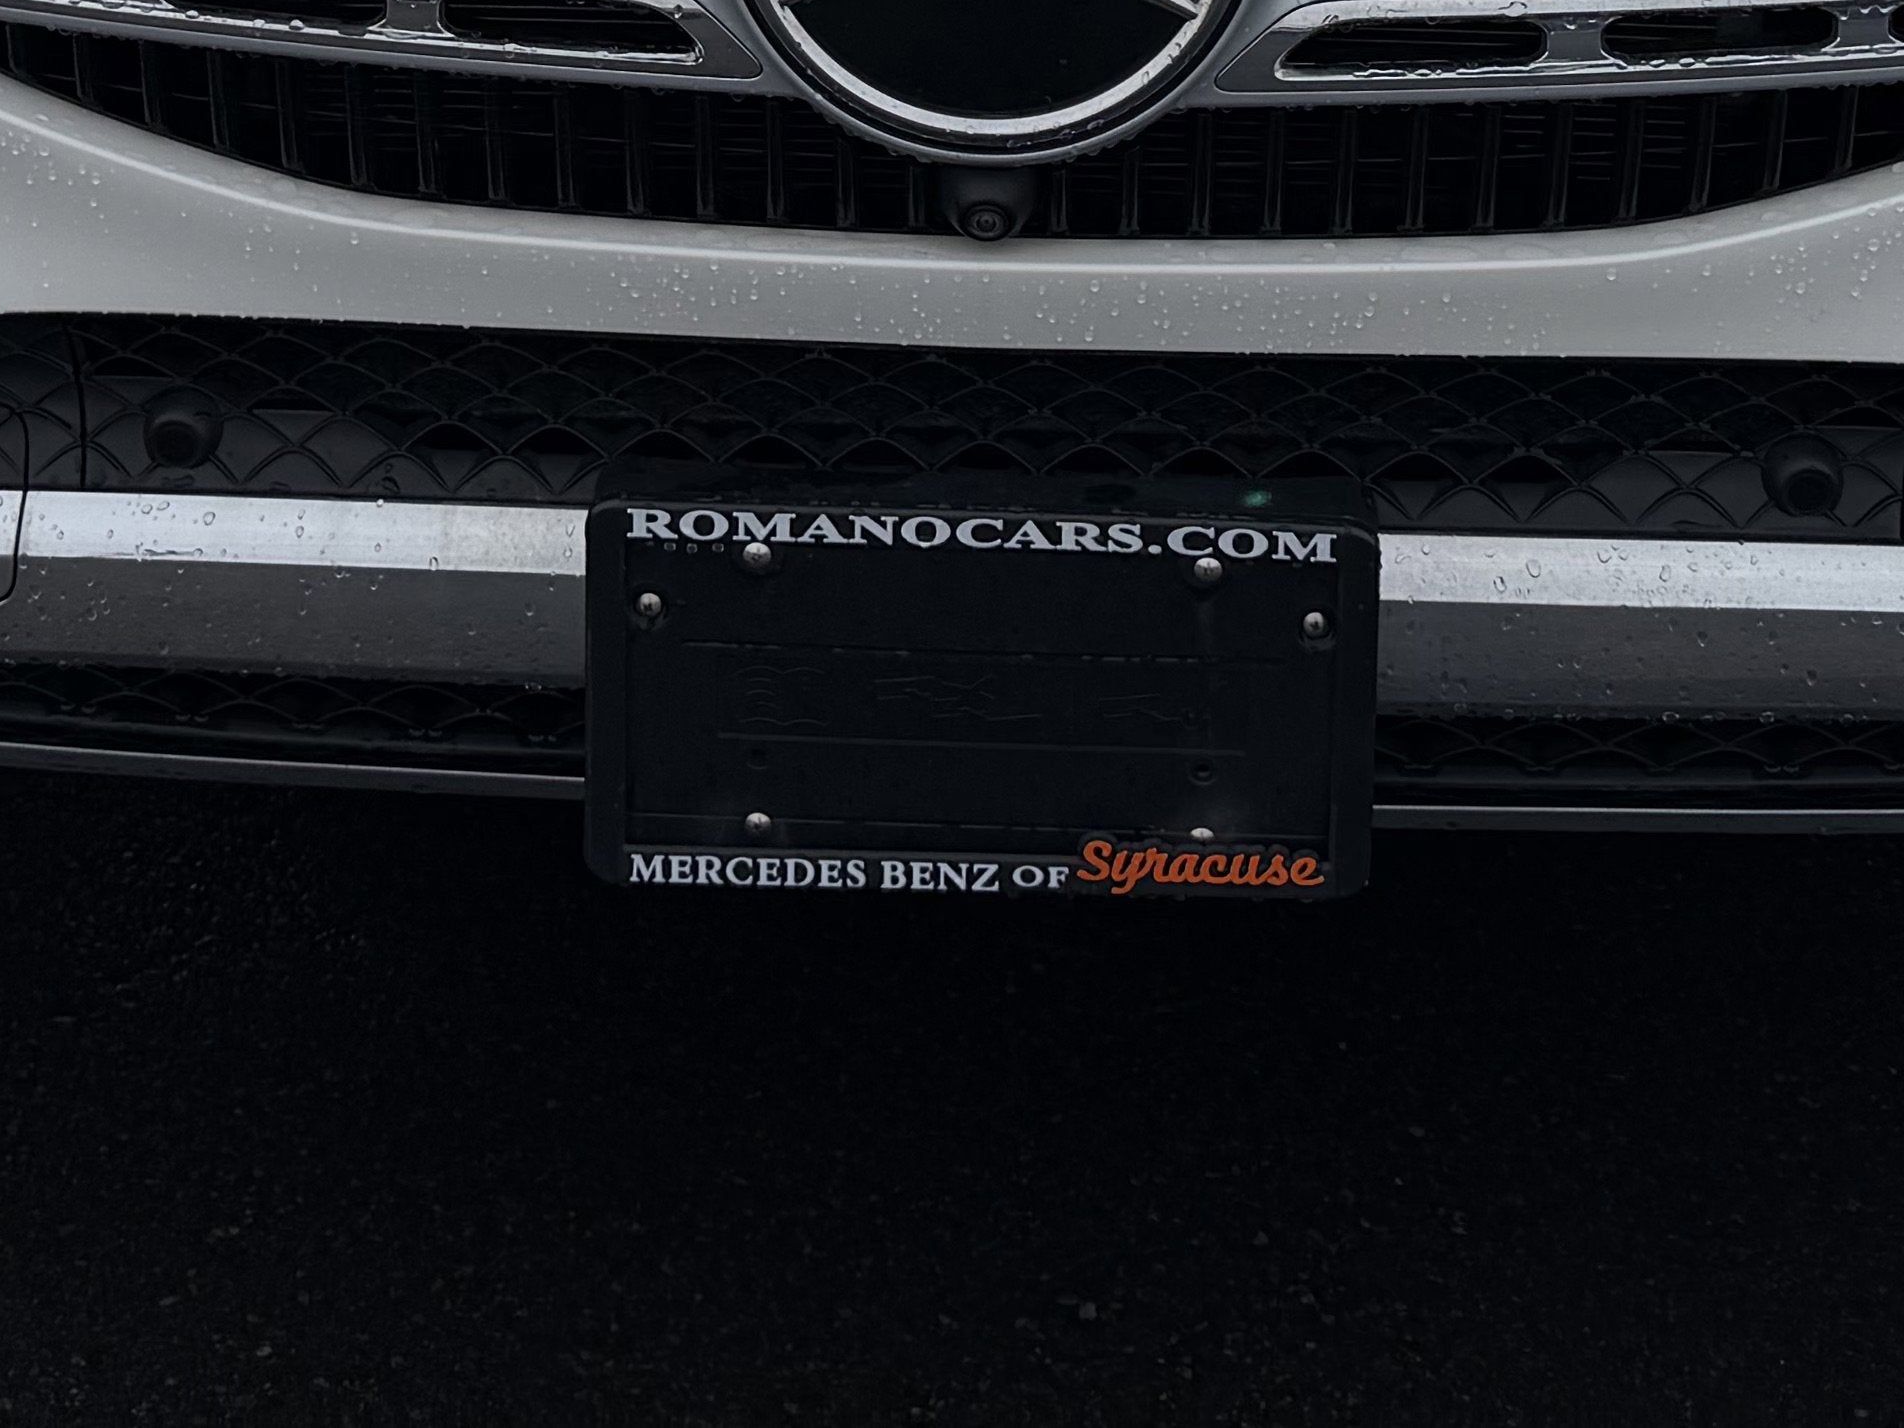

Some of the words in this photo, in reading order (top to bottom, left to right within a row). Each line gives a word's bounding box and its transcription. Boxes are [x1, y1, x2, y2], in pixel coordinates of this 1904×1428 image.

[625, 507, 1338, 563] ROMANOCARS.COM
[629, 853, 866, 887] MERCEDES
[880, 860, 1000, 892] BENZ
[1012, 864, 1070, 891] OF
[1076, 840, 1325, 895] Syracuse
